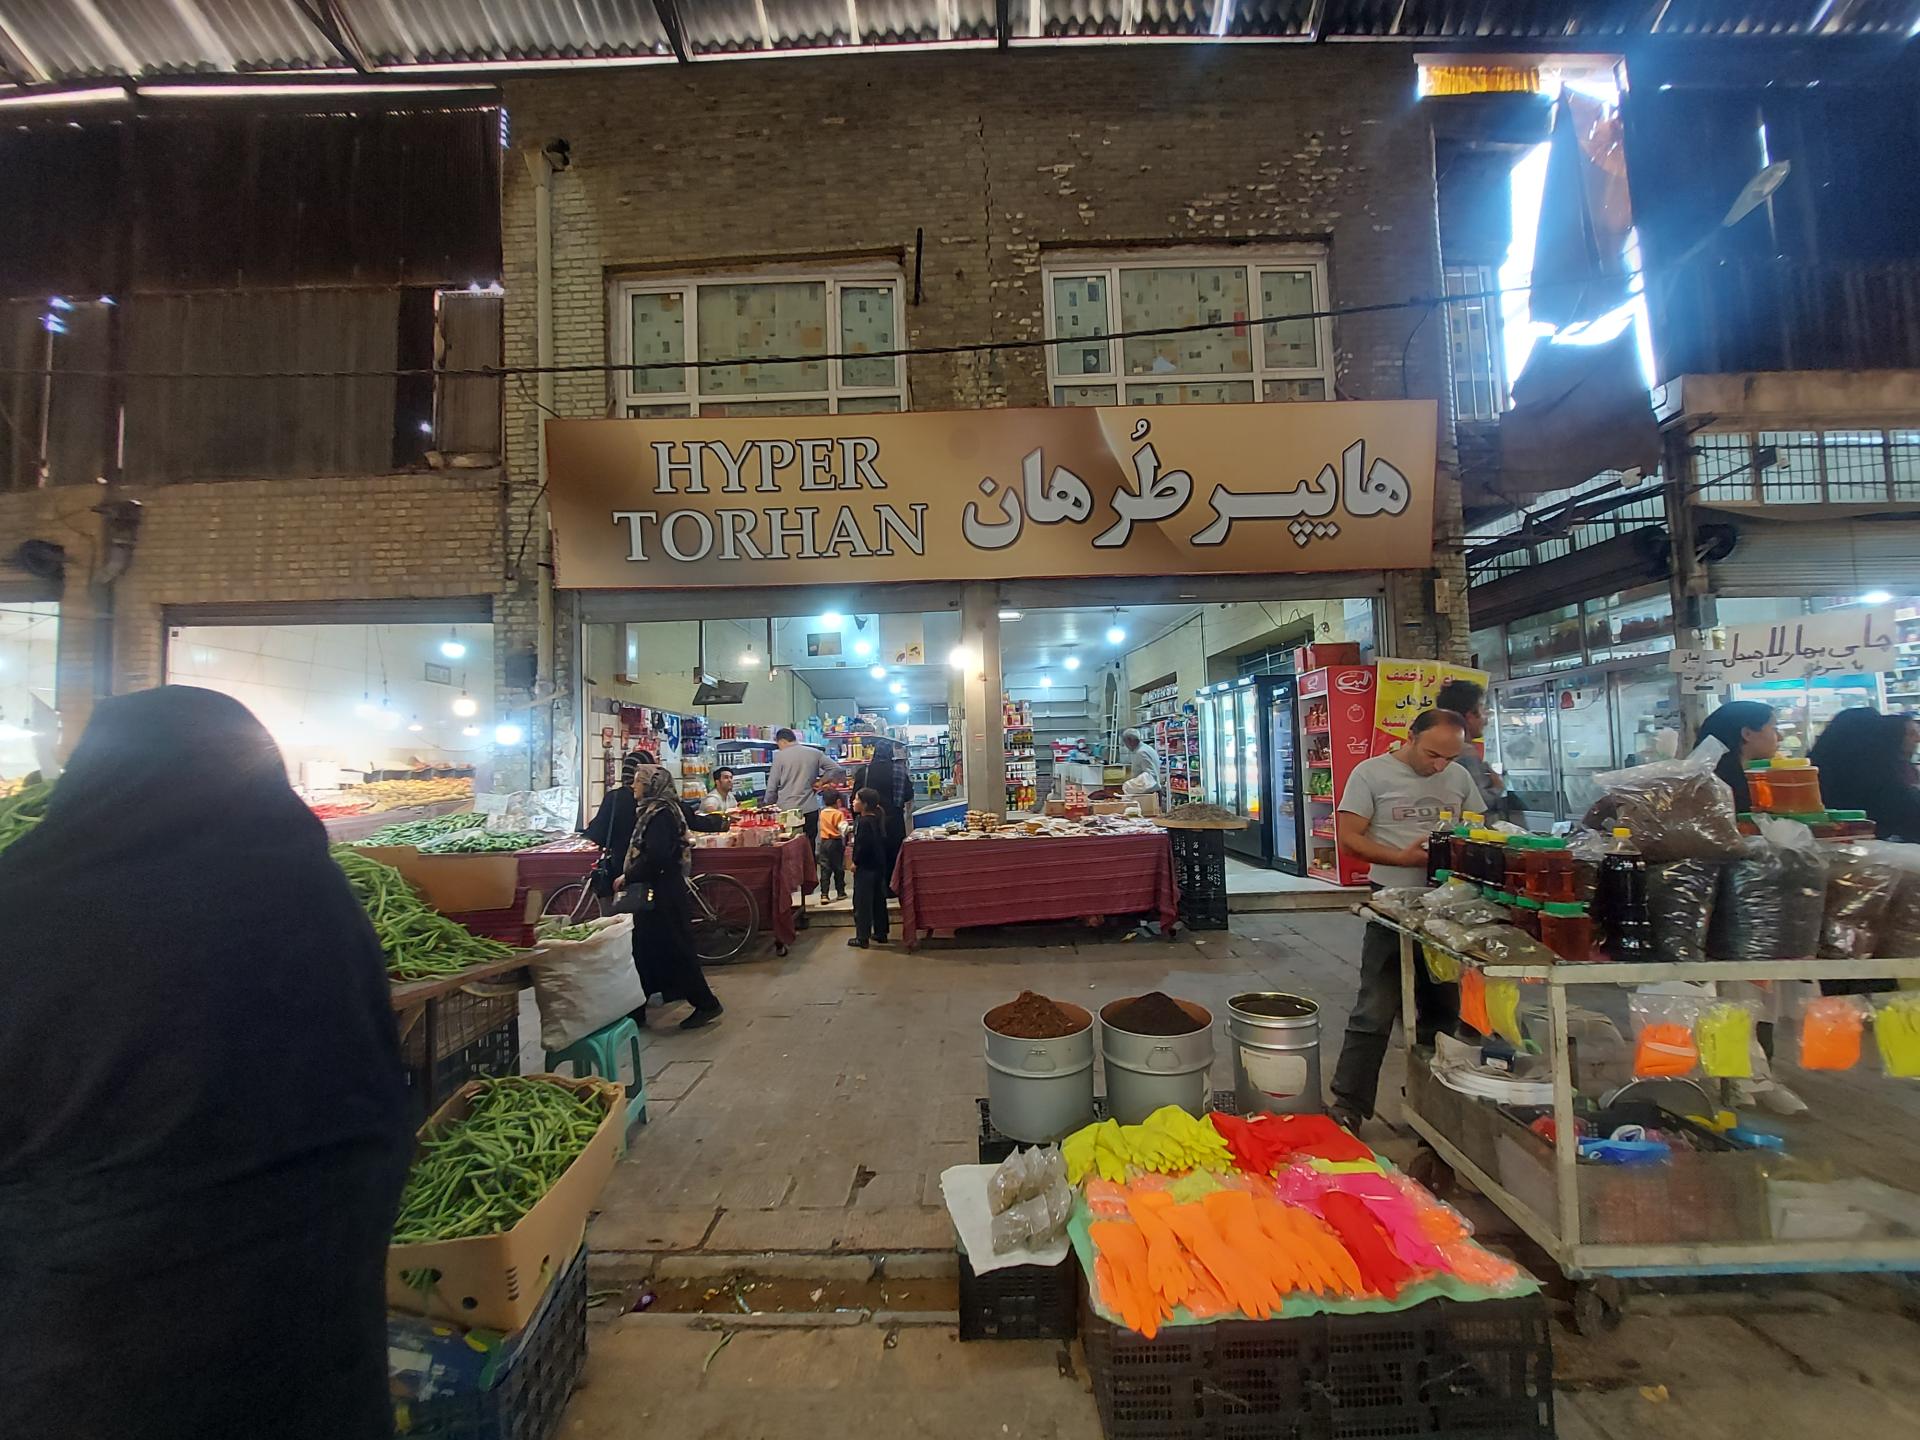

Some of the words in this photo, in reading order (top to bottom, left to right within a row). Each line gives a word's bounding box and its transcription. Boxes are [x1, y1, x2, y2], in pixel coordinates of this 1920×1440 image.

[650, 435, 888, 495] HYPER
[1190, 438, 1411, 548] هایپر
[612, 502, 929, 564] TORHAN
[1385, 668, 1425, 686] تخفیف
